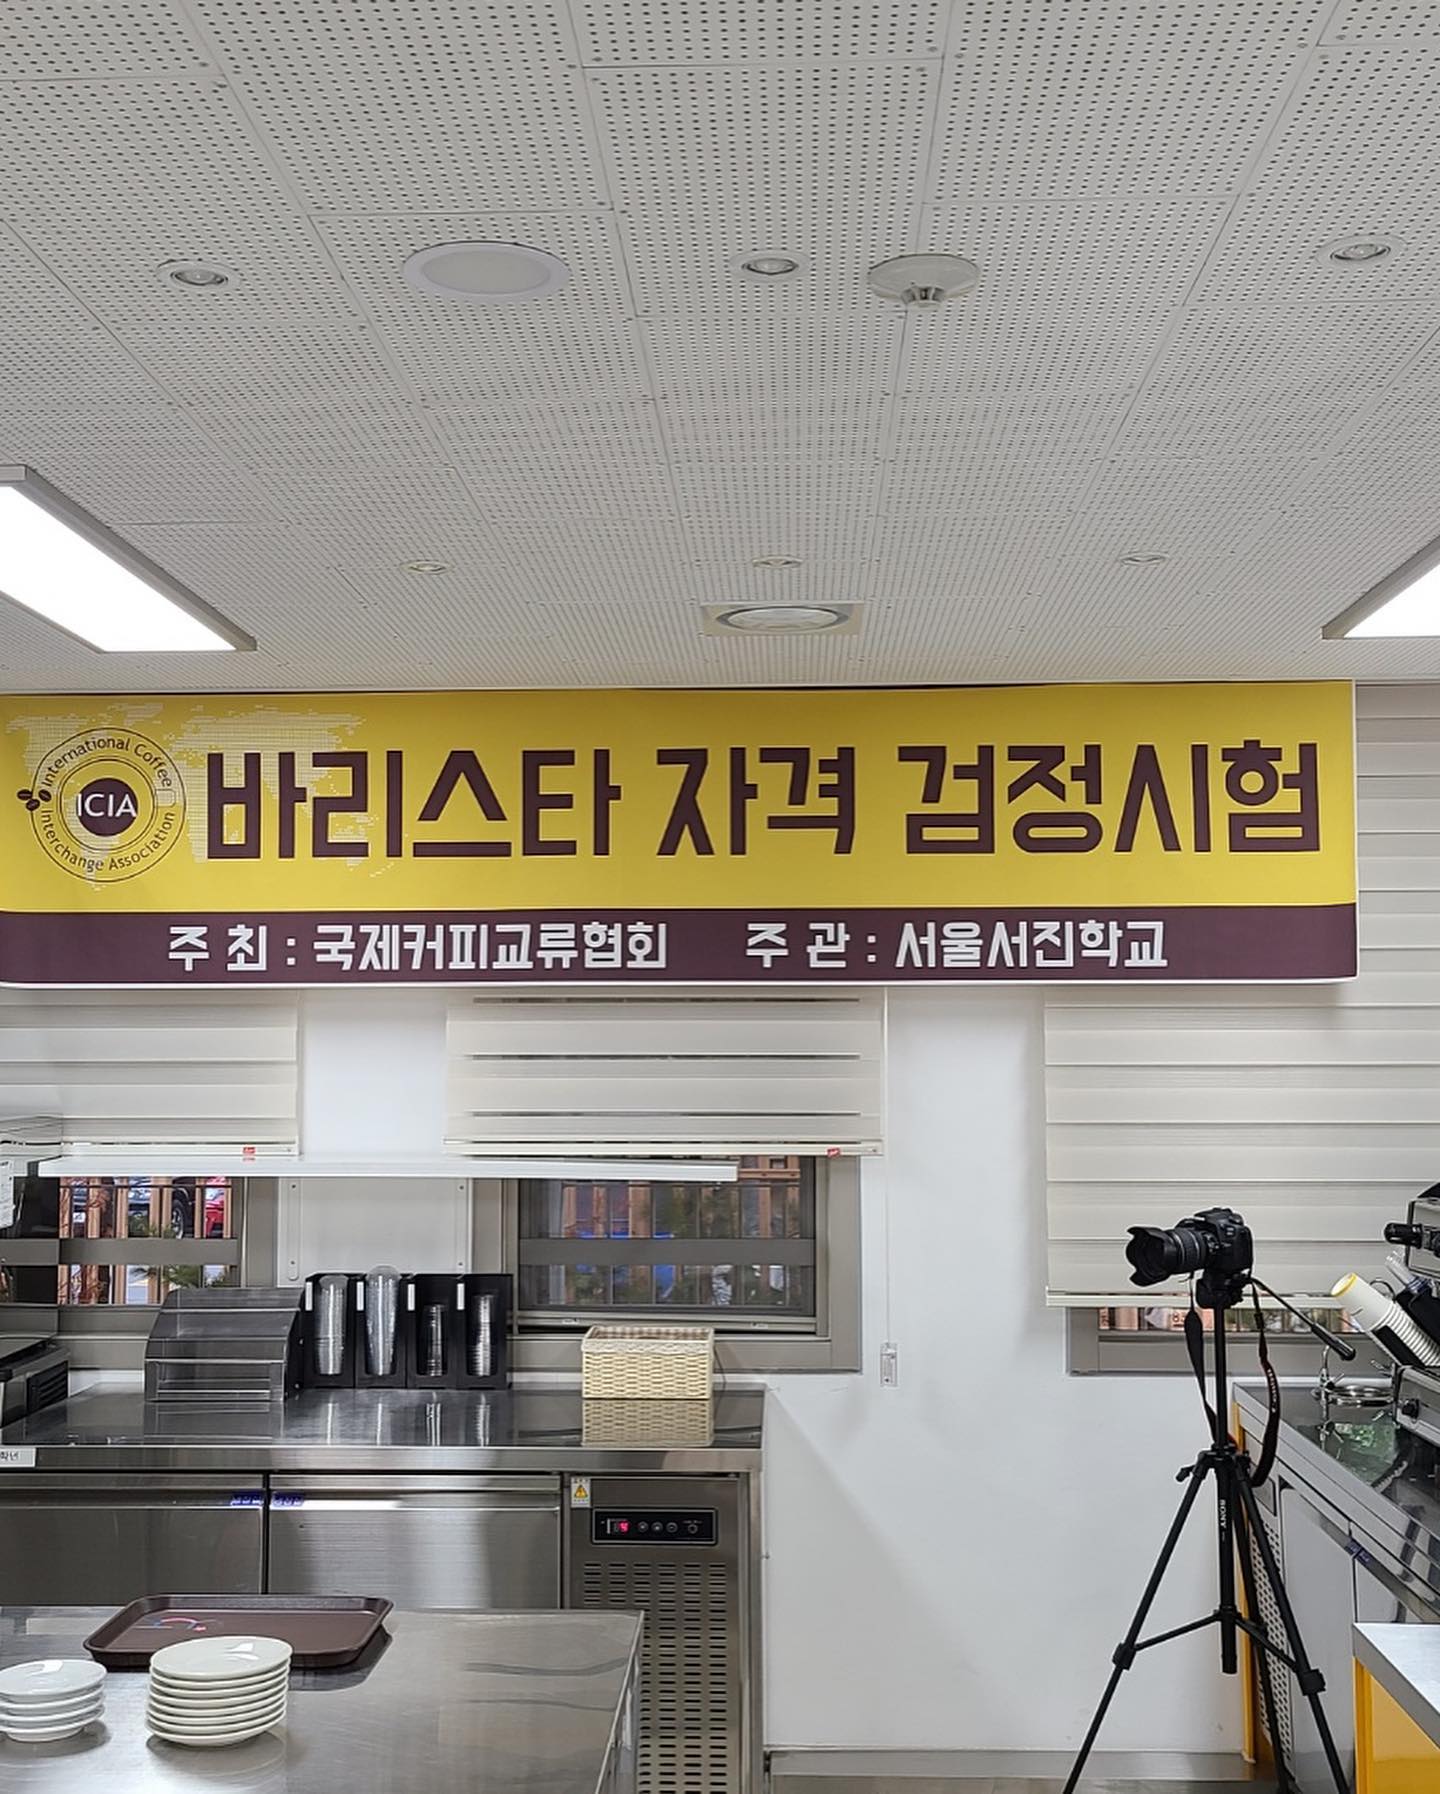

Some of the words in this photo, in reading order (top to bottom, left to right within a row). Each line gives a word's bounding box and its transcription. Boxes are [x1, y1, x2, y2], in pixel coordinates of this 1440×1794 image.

[41, 737, 131, 788] International
[134, 743, 173, 788] Coffee
[76, 793, 138, 818] ICIA
[208, 749, 621, 860] 바리스타
[656, 746, 856, 856] 자격
[897, 739, 1321, 855] 검정시험
[41, 809, 104, 873] Interchange
[109, 811, 175, 871] Association
[313, 921, 667, 971] 국제커피교류협회
[895, 919, 1169, 968] 서울서진학교
